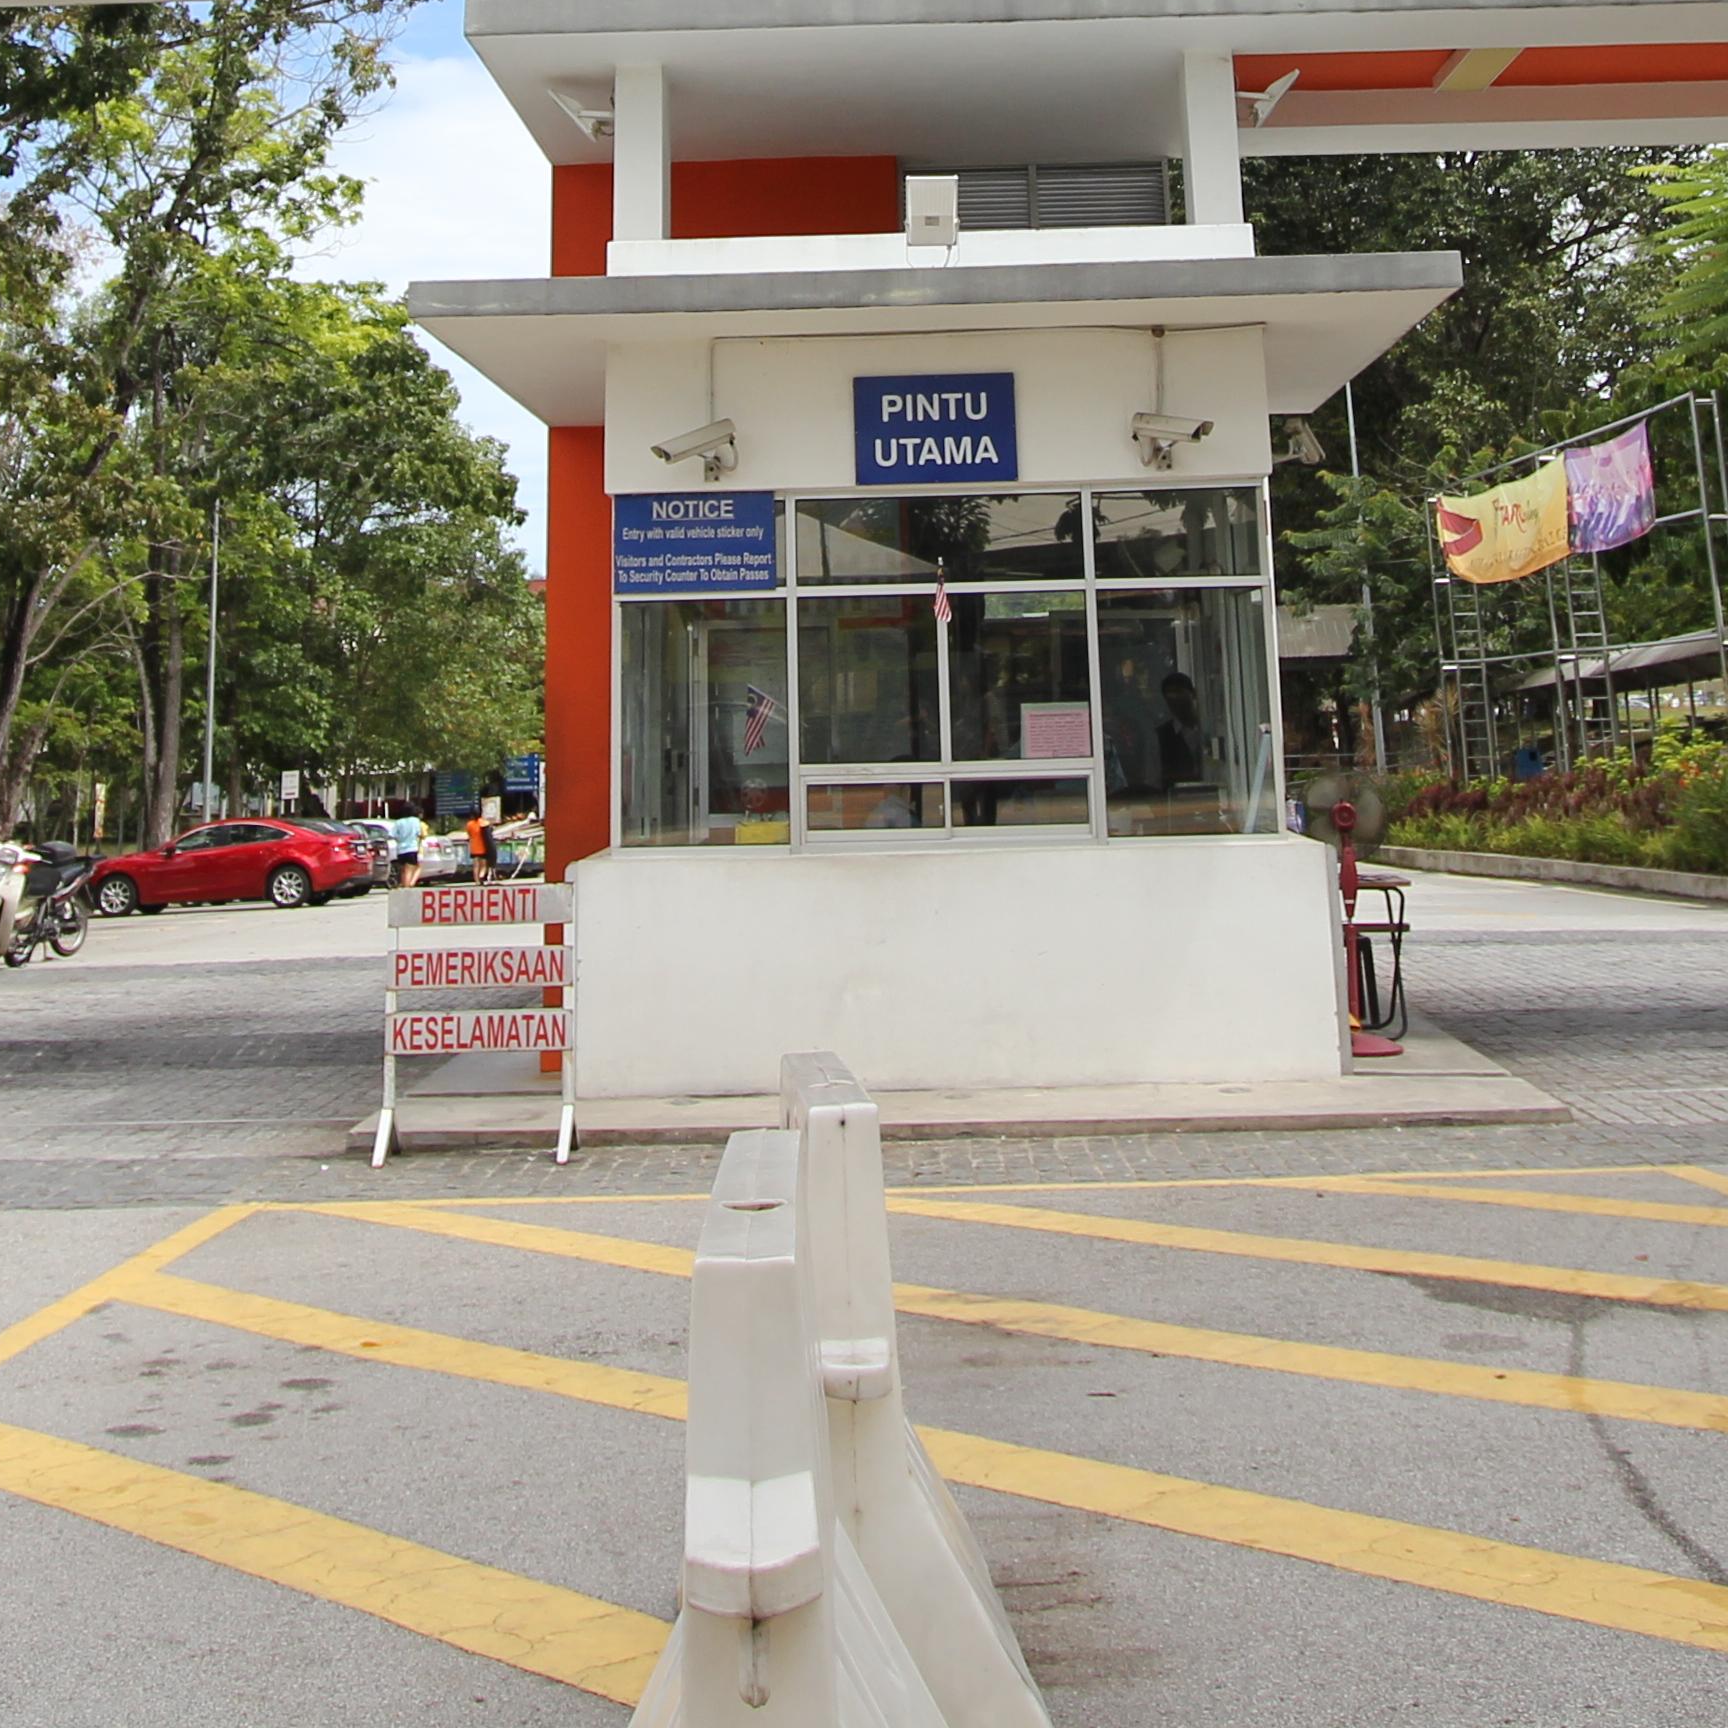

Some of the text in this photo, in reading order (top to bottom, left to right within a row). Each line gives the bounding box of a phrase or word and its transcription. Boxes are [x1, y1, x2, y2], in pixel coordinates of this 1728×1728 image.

[881, 391, 988, 423] PINTU
[874, 435, 999, 468] UTAMA
[652, 500, 734, 521] NOTICE
[622, 525, 764, 543] Entry with valid vehicle sticker only
[615, 552, 772, 567] Visitors and Contractors Please Report
[618, 568, 769, 585] To Security Counter To Obtain Passes
[422, 888, 537, 923] BERHENTI
[395, 950, 565, 987] PEMERIKSAAN
[393, 1014, 566, 1051] KESELAMATAN
